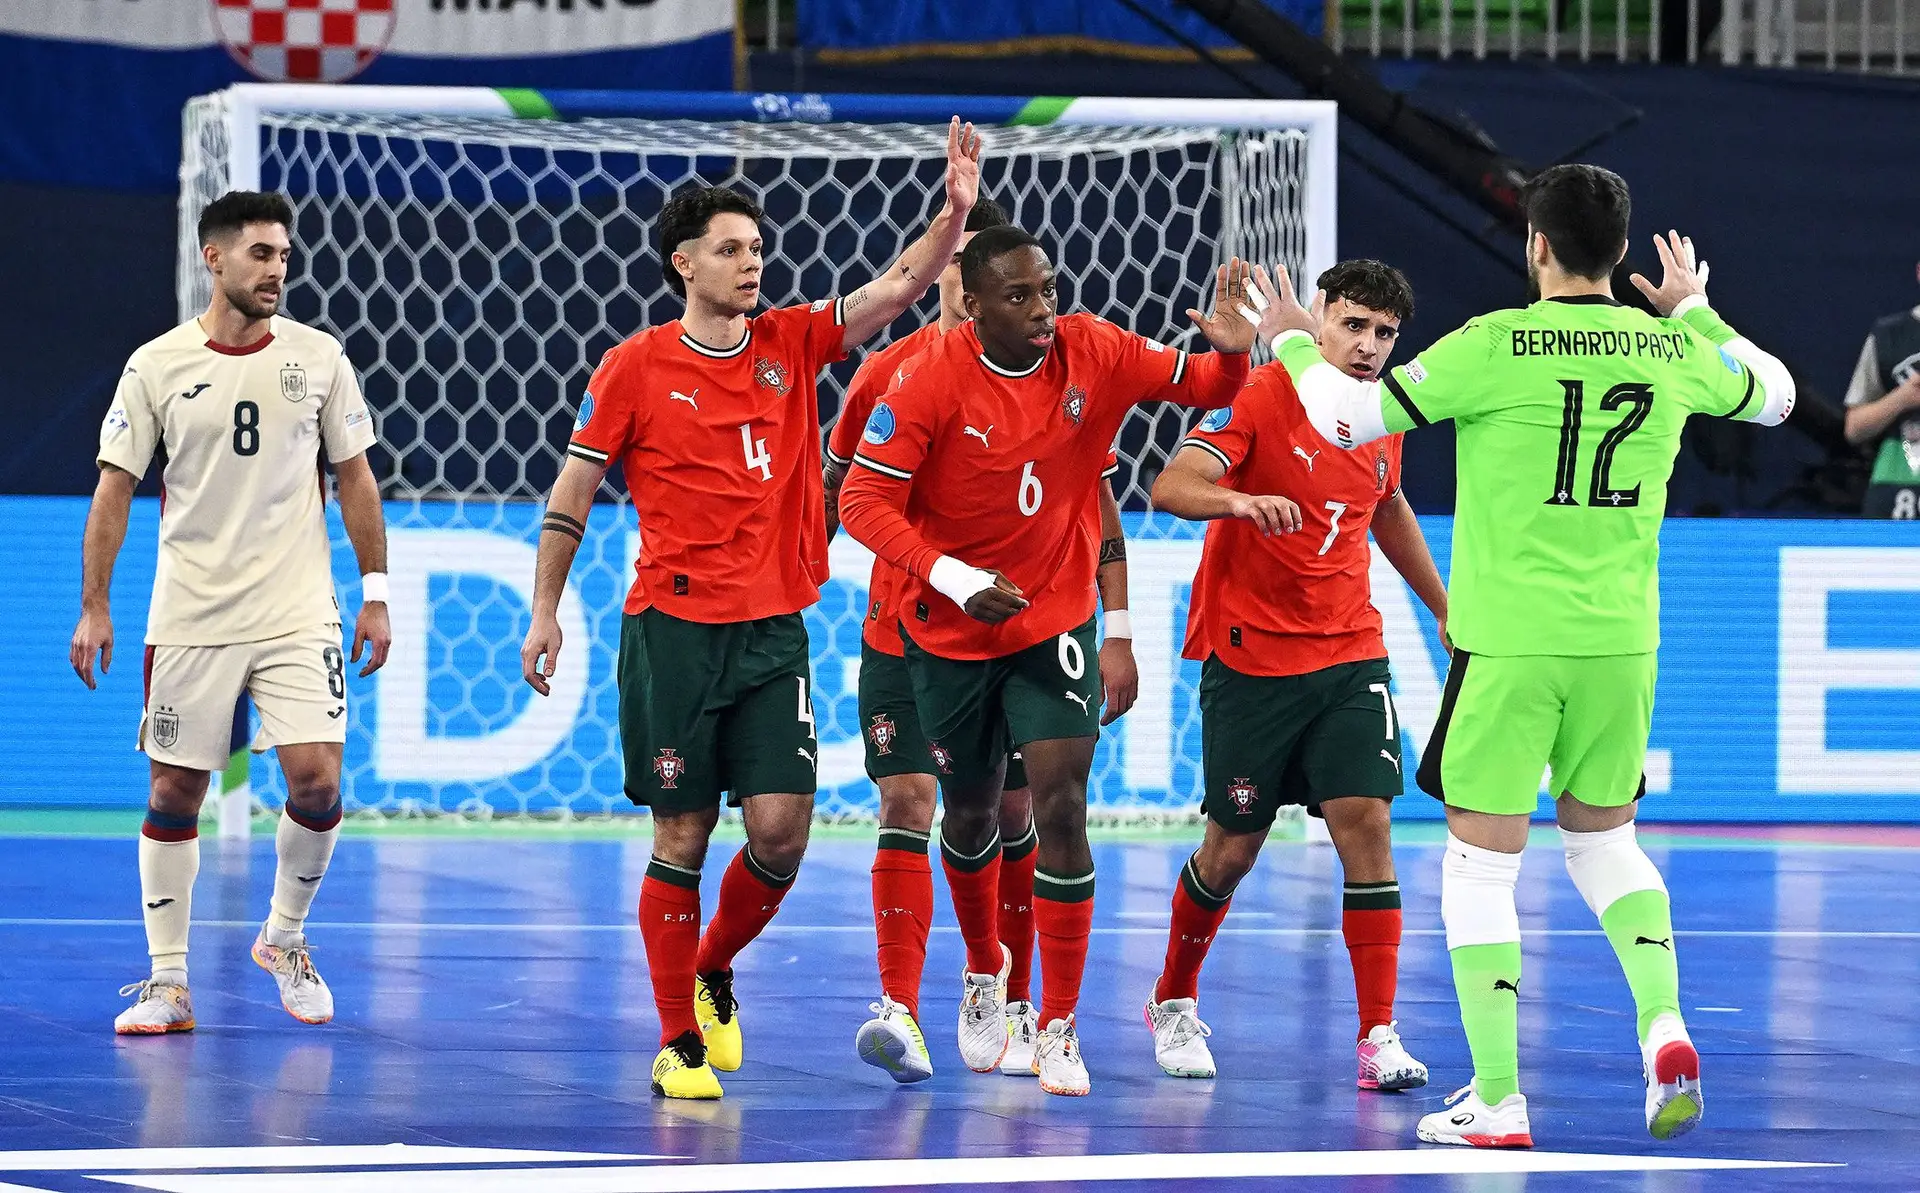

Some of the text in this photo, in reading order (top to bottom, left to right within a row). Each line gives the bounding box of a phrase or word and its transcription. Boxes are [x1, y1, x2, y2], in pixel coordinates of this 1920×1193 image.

[1512, 329, 1631, 357] BERNARDO
[233, 400, 260, 457] 8
[738, 423, 774, 482] 4
[1543, 379, 1654, 507] 12
[1018, 461, 1043, 517] 6
[1318, 500, 1349, 556] 7
[323, 646, 345, 700] 8
[1058, 631, 1085, 681] 6
[796, 675, 818, 740] 4
[1369, 683, 1394, 740] 7
